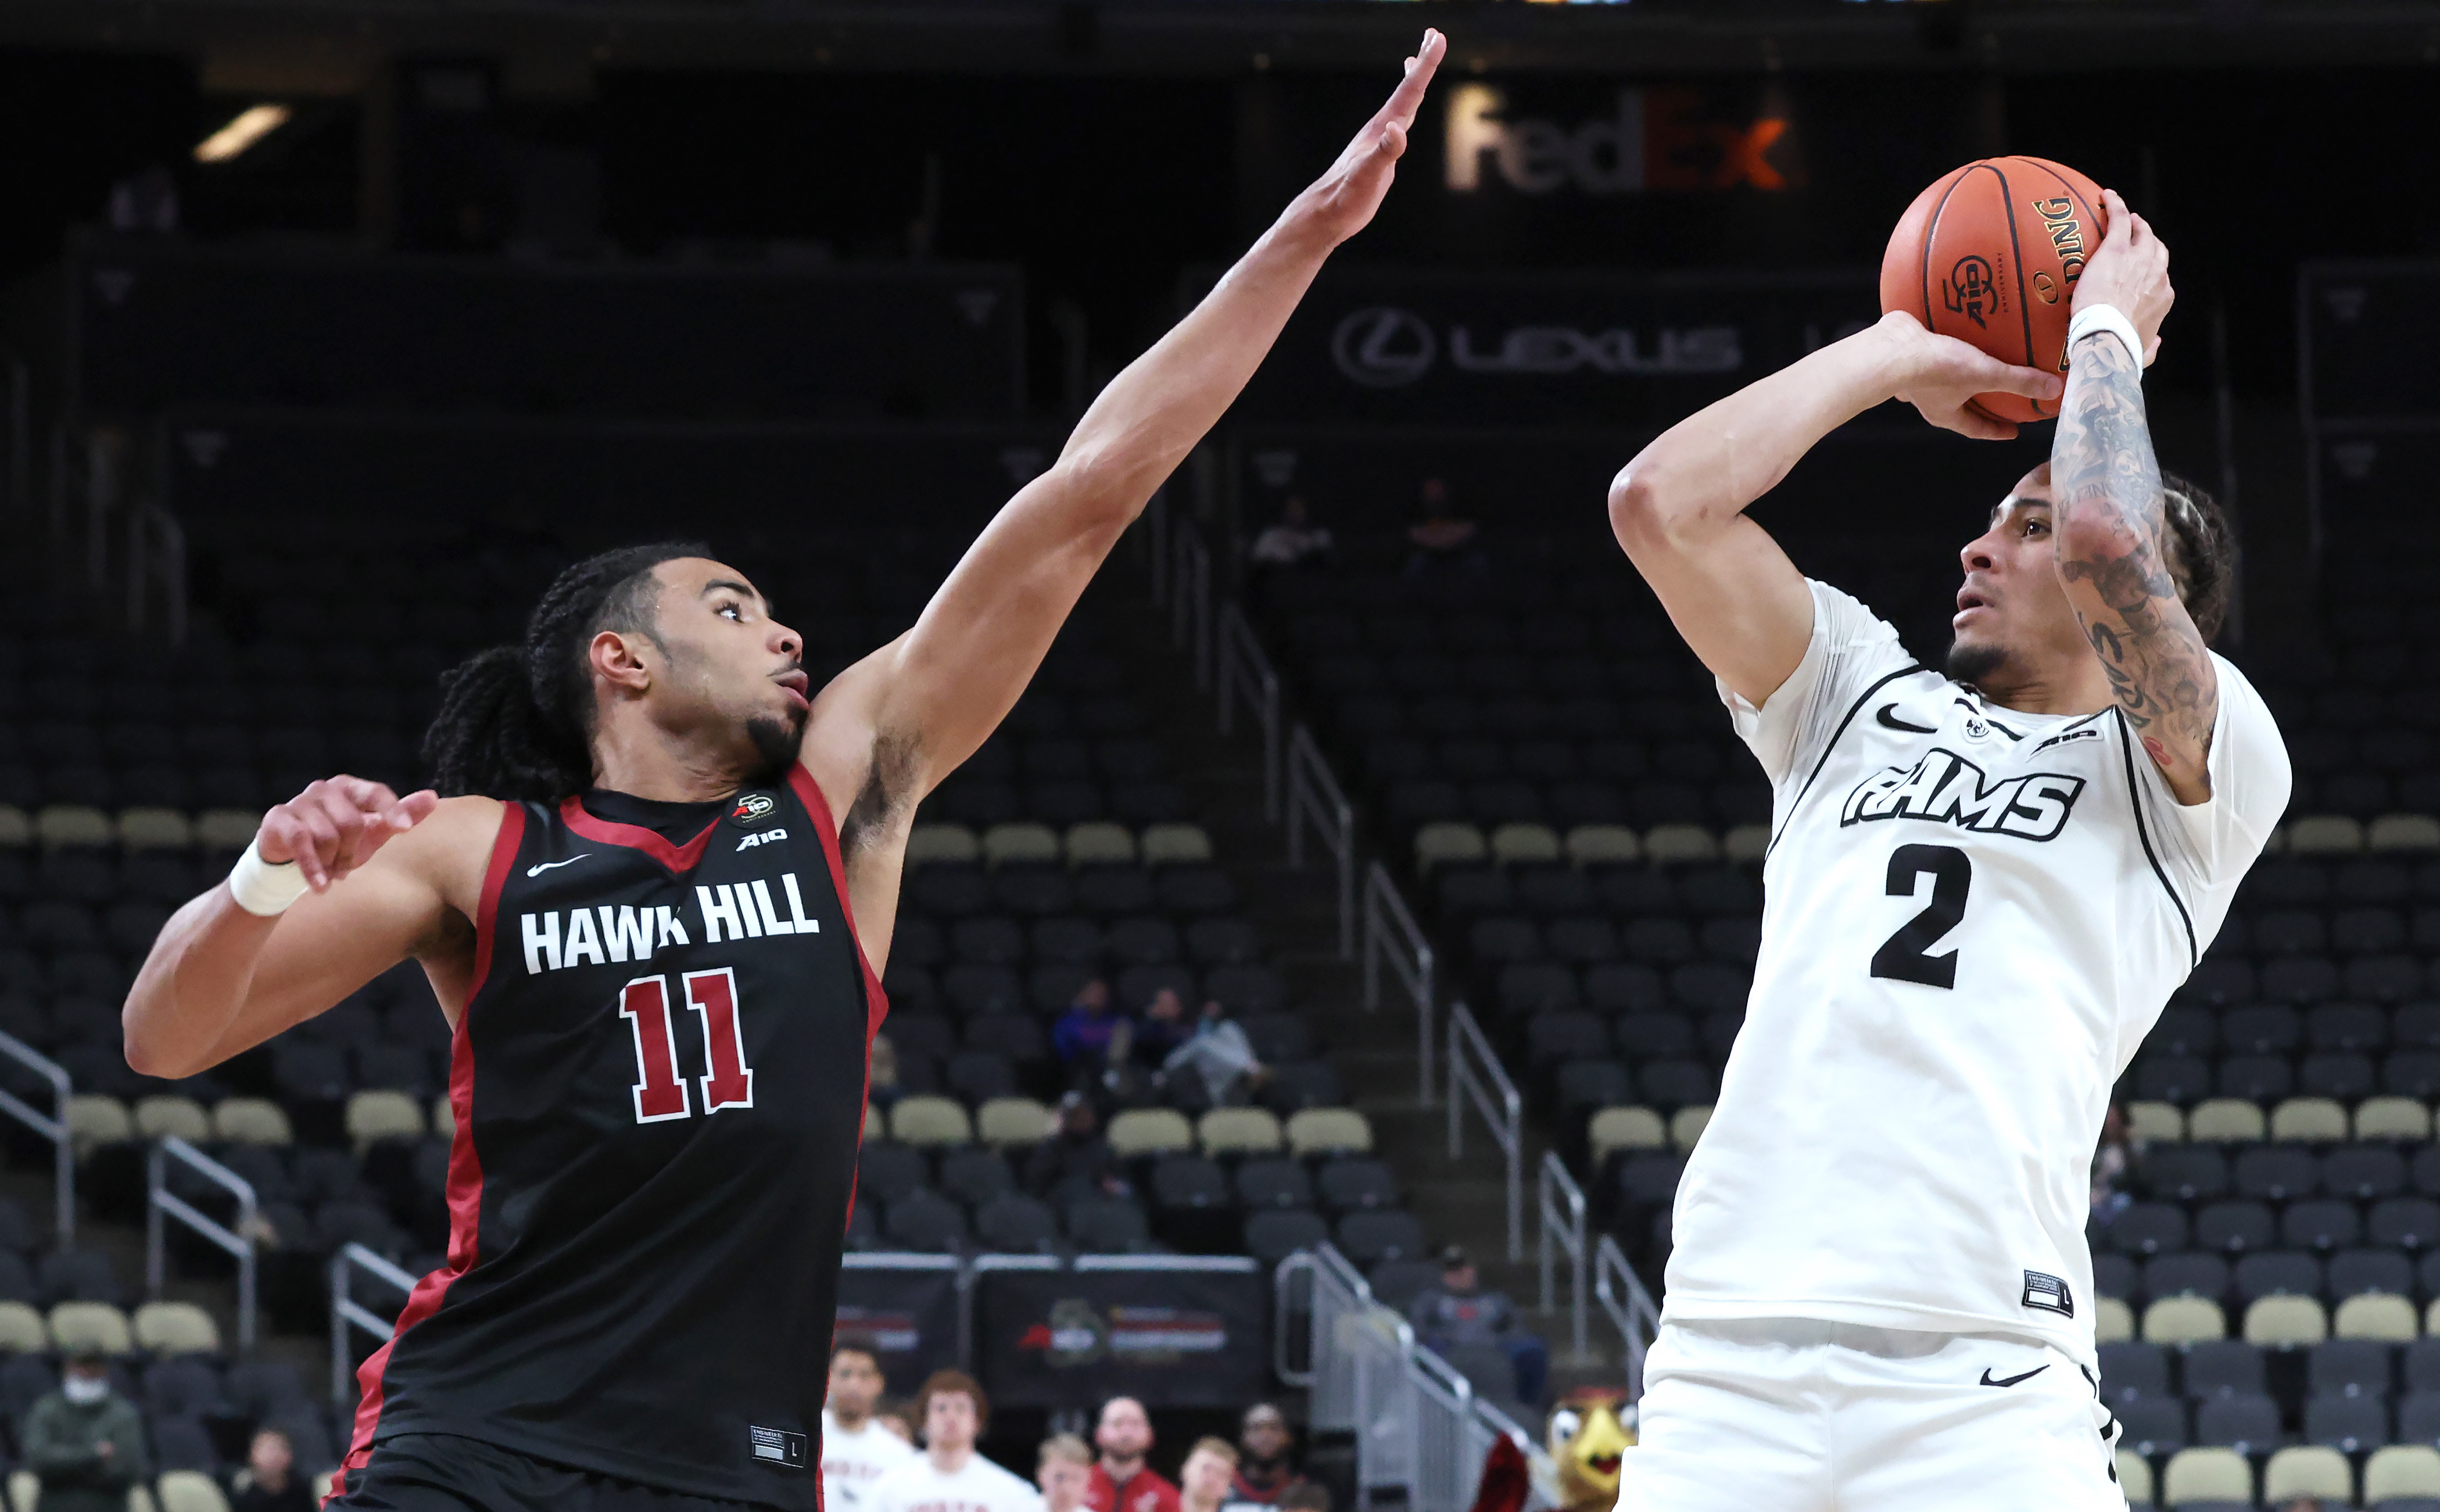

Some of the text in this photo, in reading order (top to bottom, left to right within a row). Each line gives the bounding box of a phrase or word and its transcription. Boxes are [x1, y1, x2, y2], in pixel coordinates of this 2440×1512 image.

[1443, 82, 1807, 193] FedEx
[1451, 325, 1740, 372] LEXUS
[735, 829, 788, 852] A10
[1840, 748, 2086, 842] RAMS
[521, 873, 819, 974] HAWK HILL
[1871, 843, 1971, 990] 2
[619, 966, 753, 1124] 11
[2064, 1289, 2069, 1305] L
[792, 1442, 797, 1457] L
